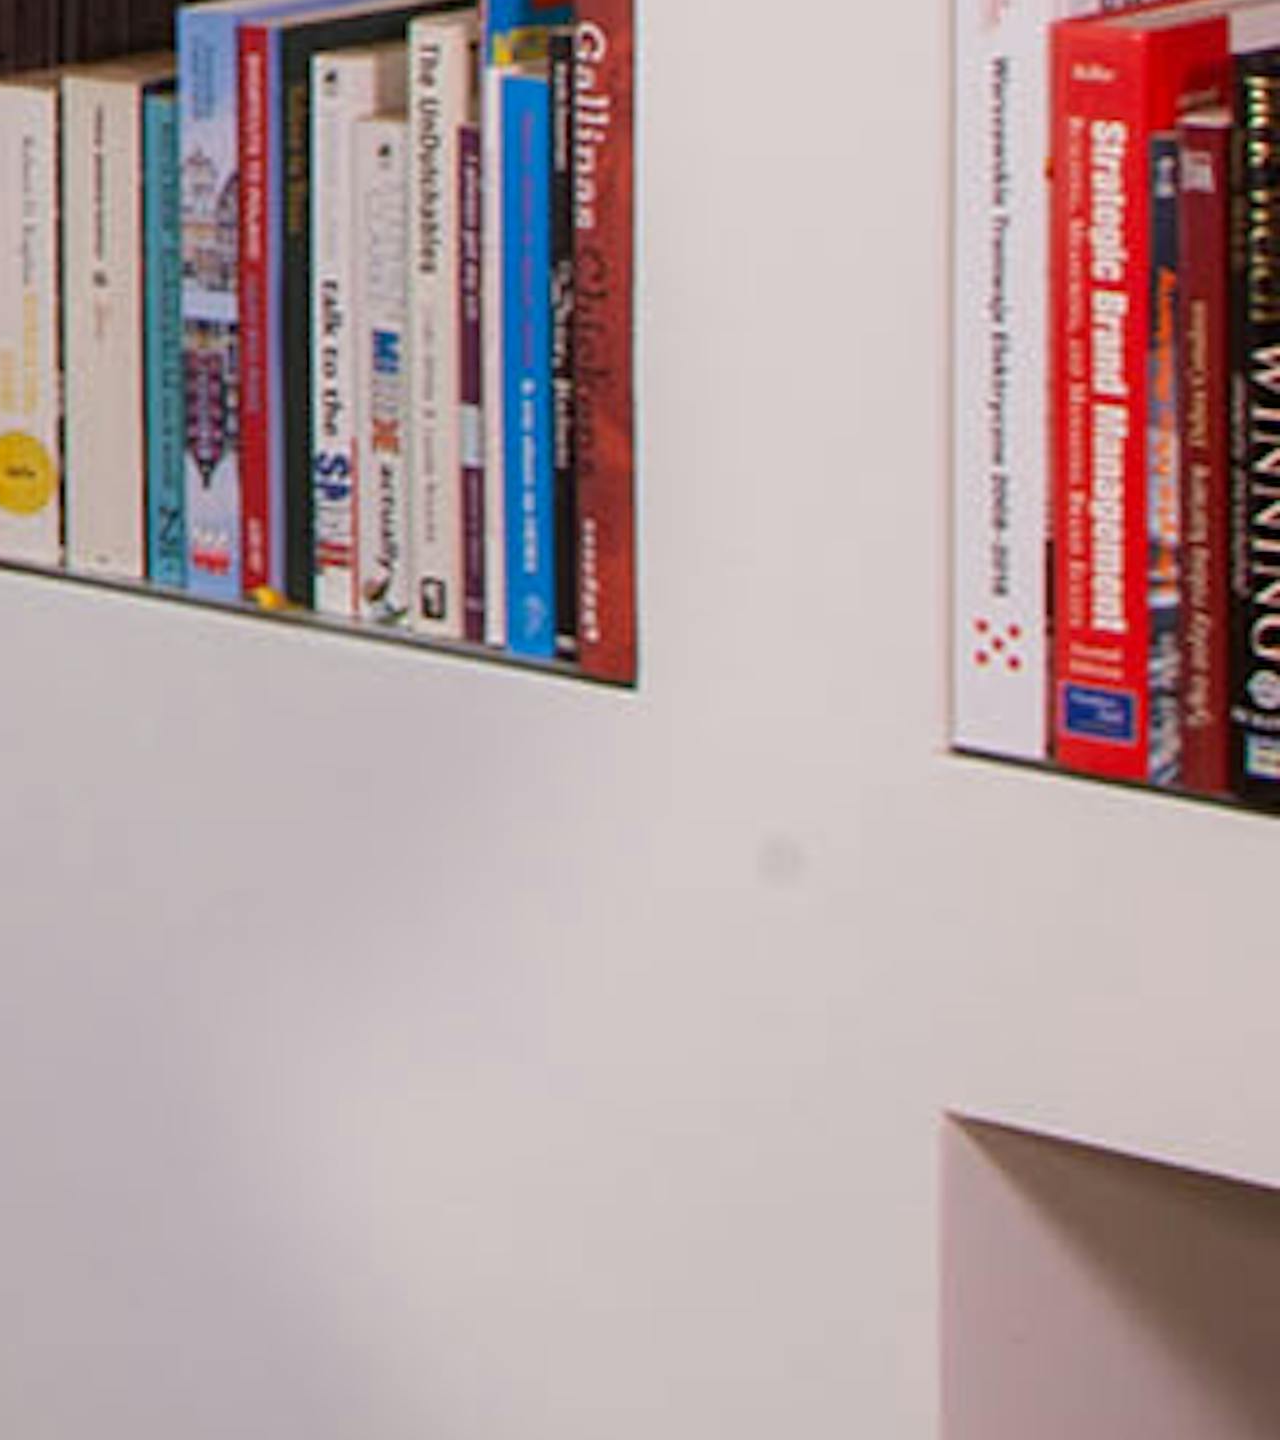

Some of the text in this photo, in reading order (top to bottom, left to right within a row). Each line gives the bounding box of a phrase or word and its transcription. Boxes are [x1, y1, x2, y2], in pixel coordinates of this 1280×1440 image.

[419, 45, 441, 87] The
[417, 97, 443, 274] UnDutchables
[322, 280, 344, 436] talk to the
[1085, 119, 1130, 633] Strategic Brand Management
